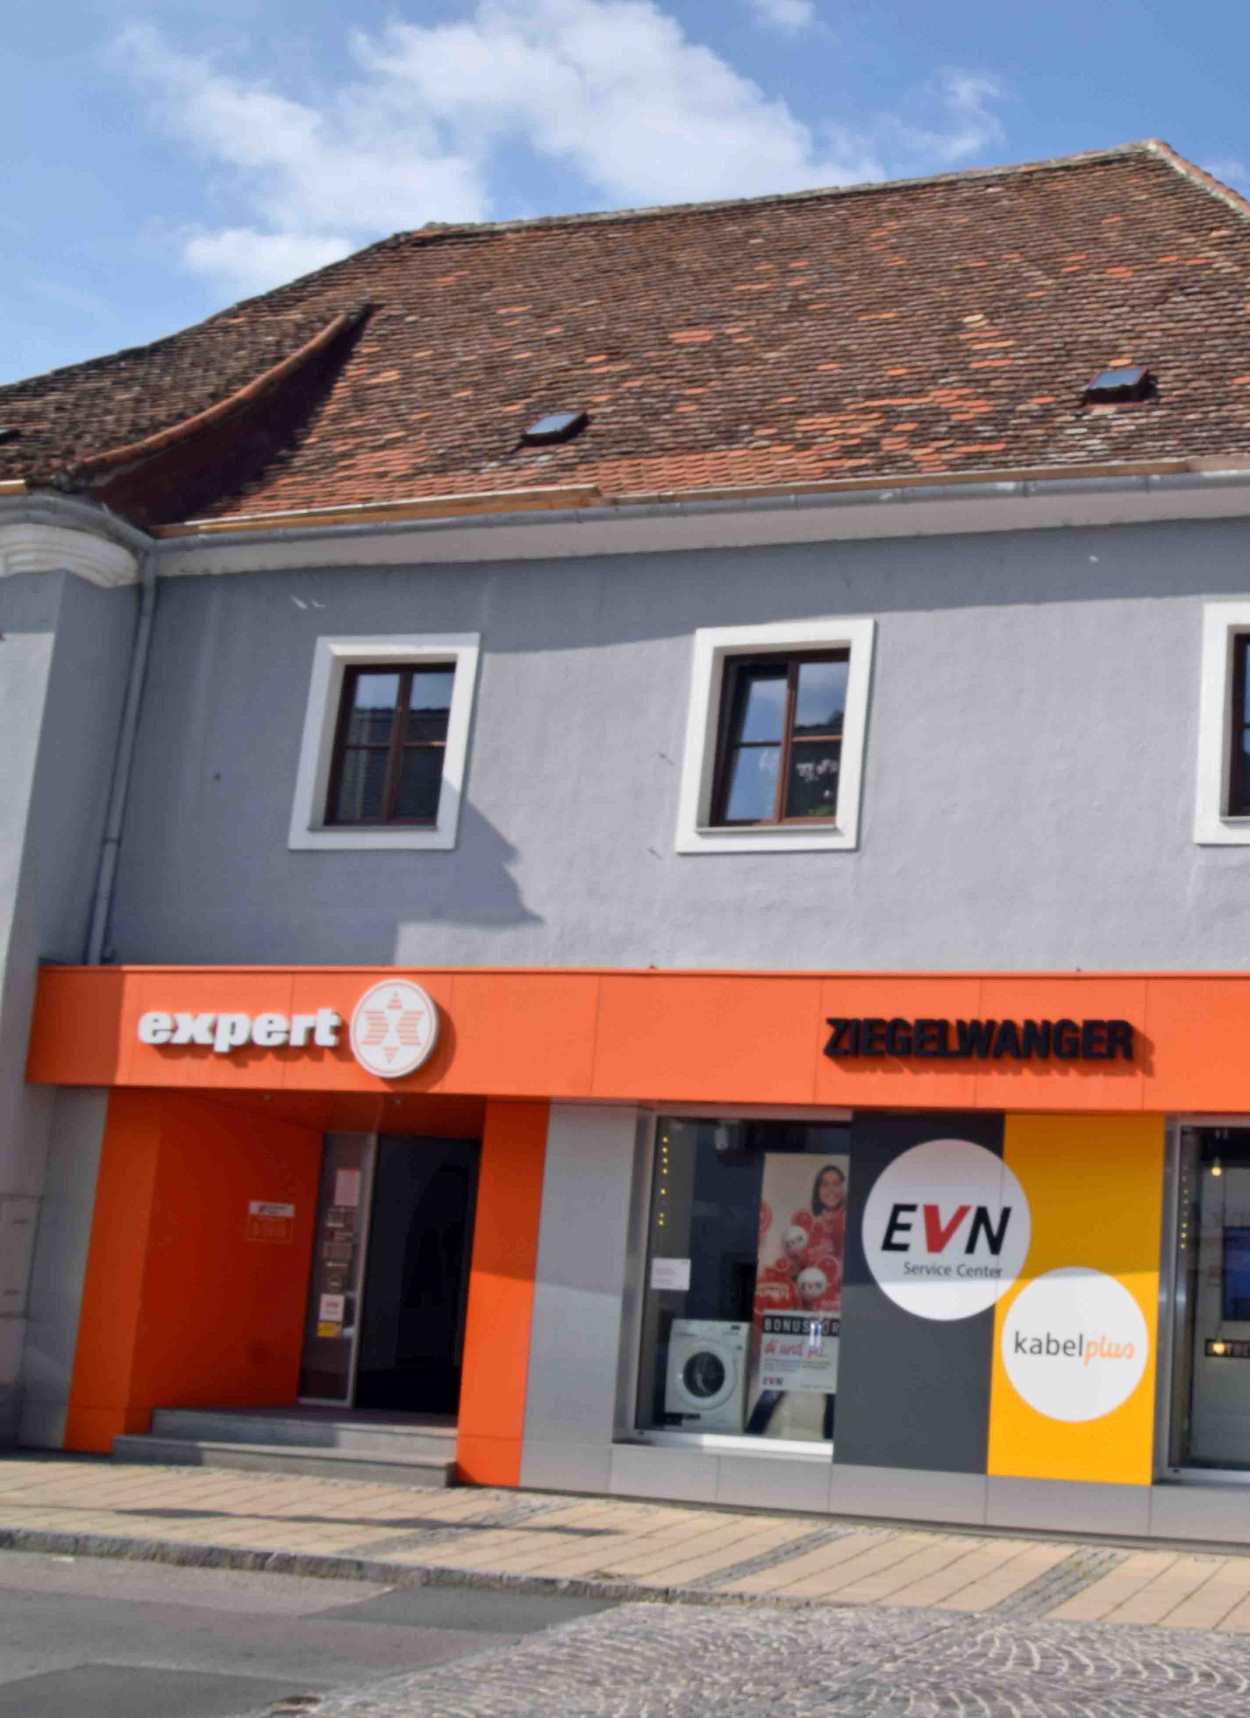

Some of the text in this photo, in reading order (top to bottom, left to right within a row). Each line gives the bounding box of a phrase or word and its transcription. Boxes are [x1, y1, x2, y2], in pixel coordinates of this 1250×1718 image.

[137, 1008, 342, 1053] expert
[823, 1018, 1135, 1060] ZIEGELWANGER
[881, 1203, 1011, 1255] EVN
[903, 1261, 1002, 1279] Service Center
